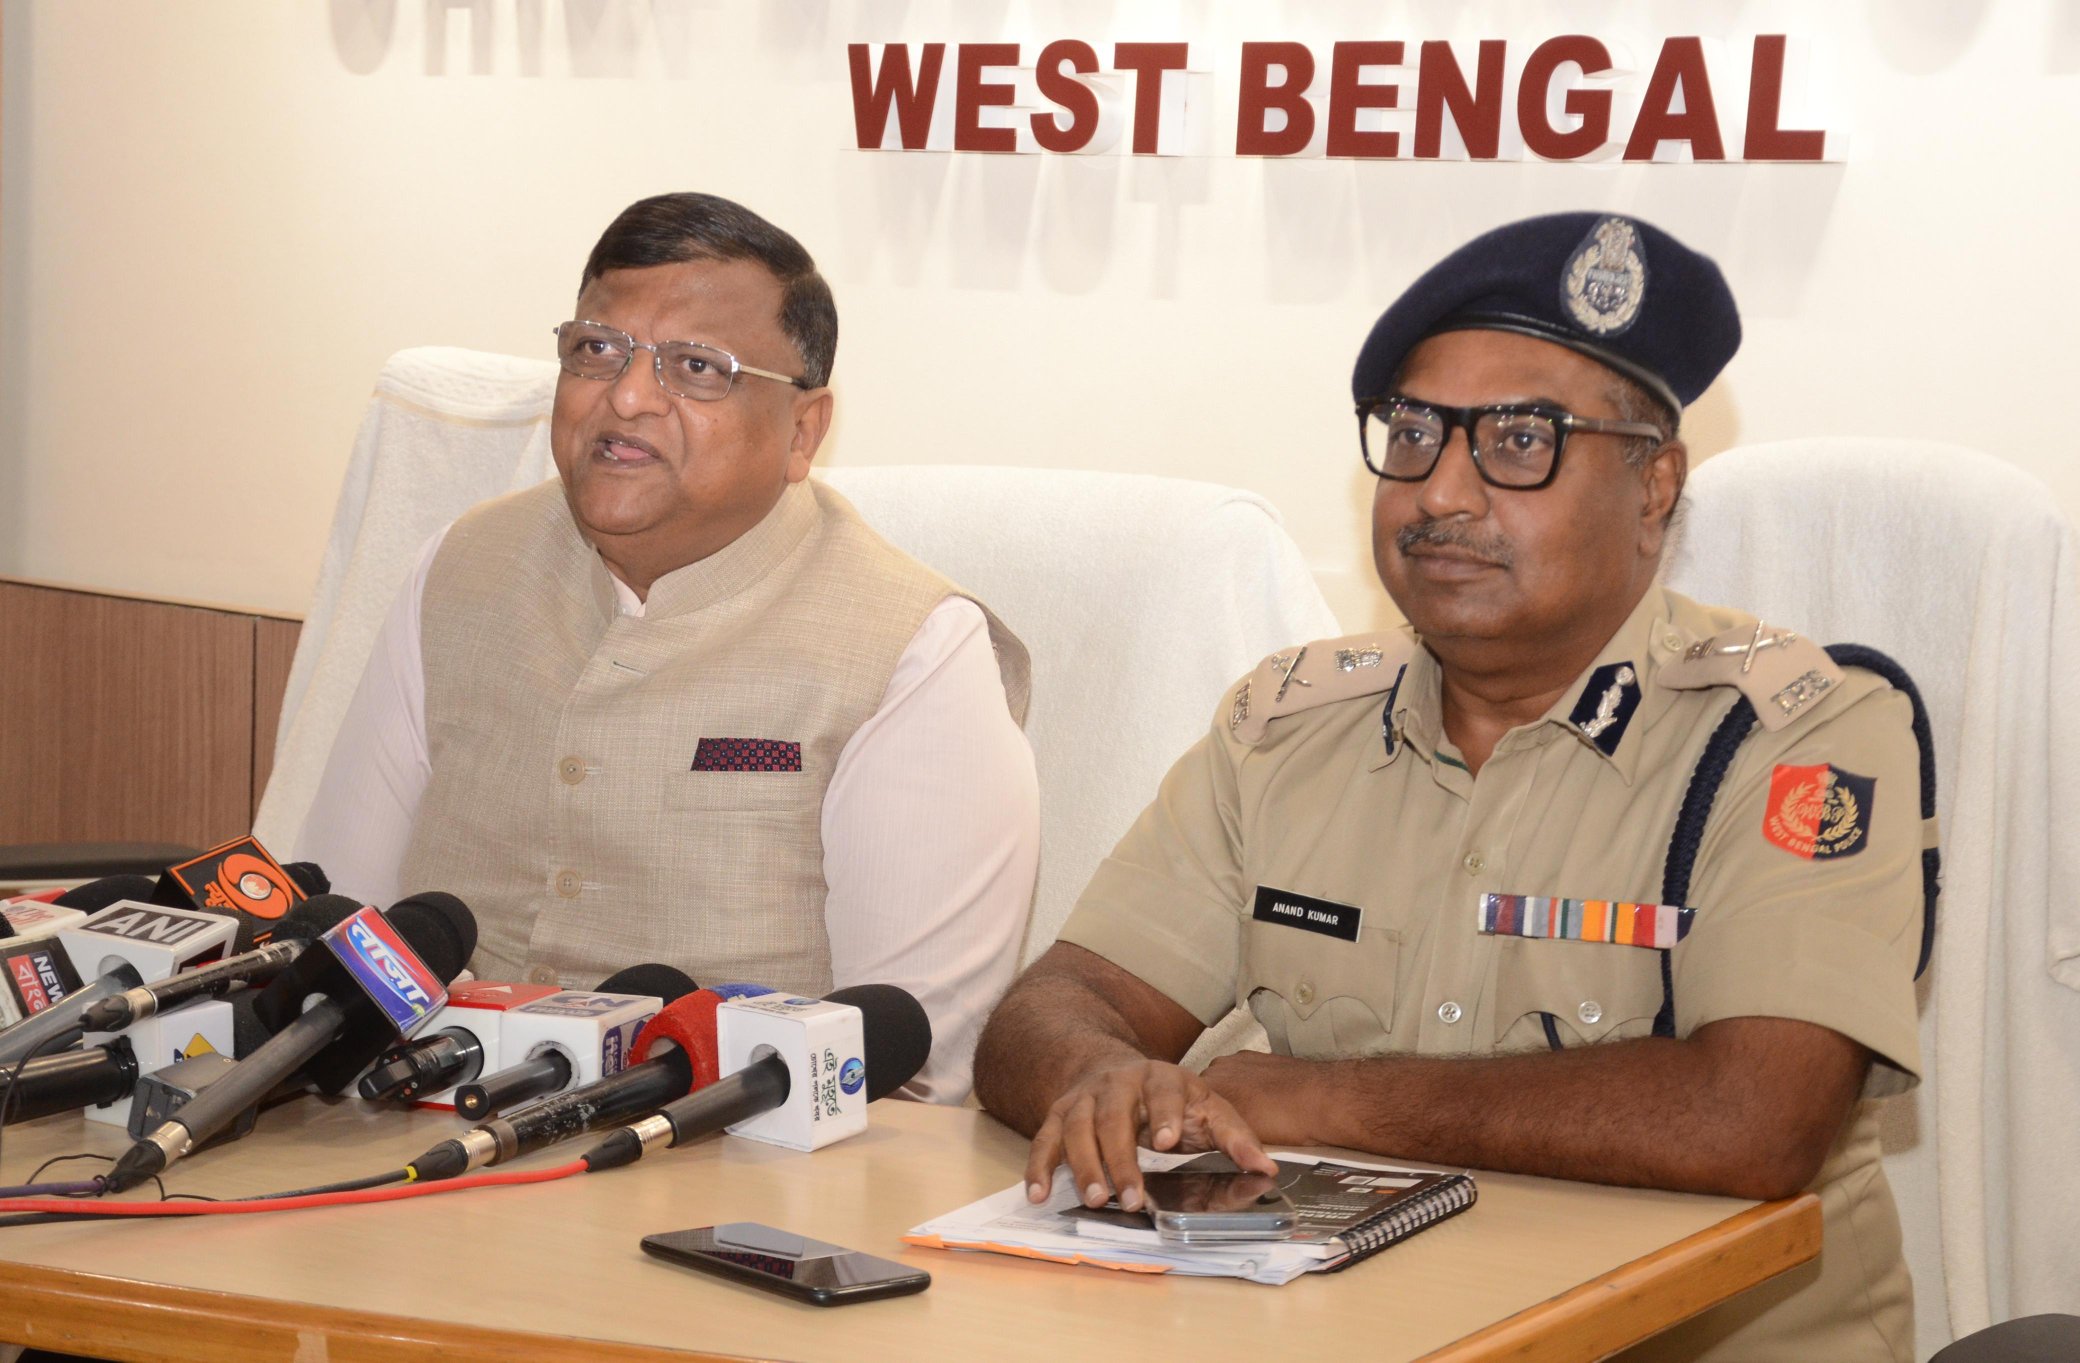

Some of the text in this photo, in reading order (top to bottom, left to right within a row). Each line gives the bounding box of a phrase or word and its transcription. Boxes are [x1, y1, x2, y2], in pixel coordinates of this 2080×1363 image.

[848, 34, 1825, 160] WEST BENGAL
[1769, 815, 1790, 840] WEST
[1787, 838, 1832, 854] BENGAL
[88, 912, 206, 943] ANI
[1272, 902, 1339, 925] ANAND KUMAR
[33, 956, 64, 1003] NEW
